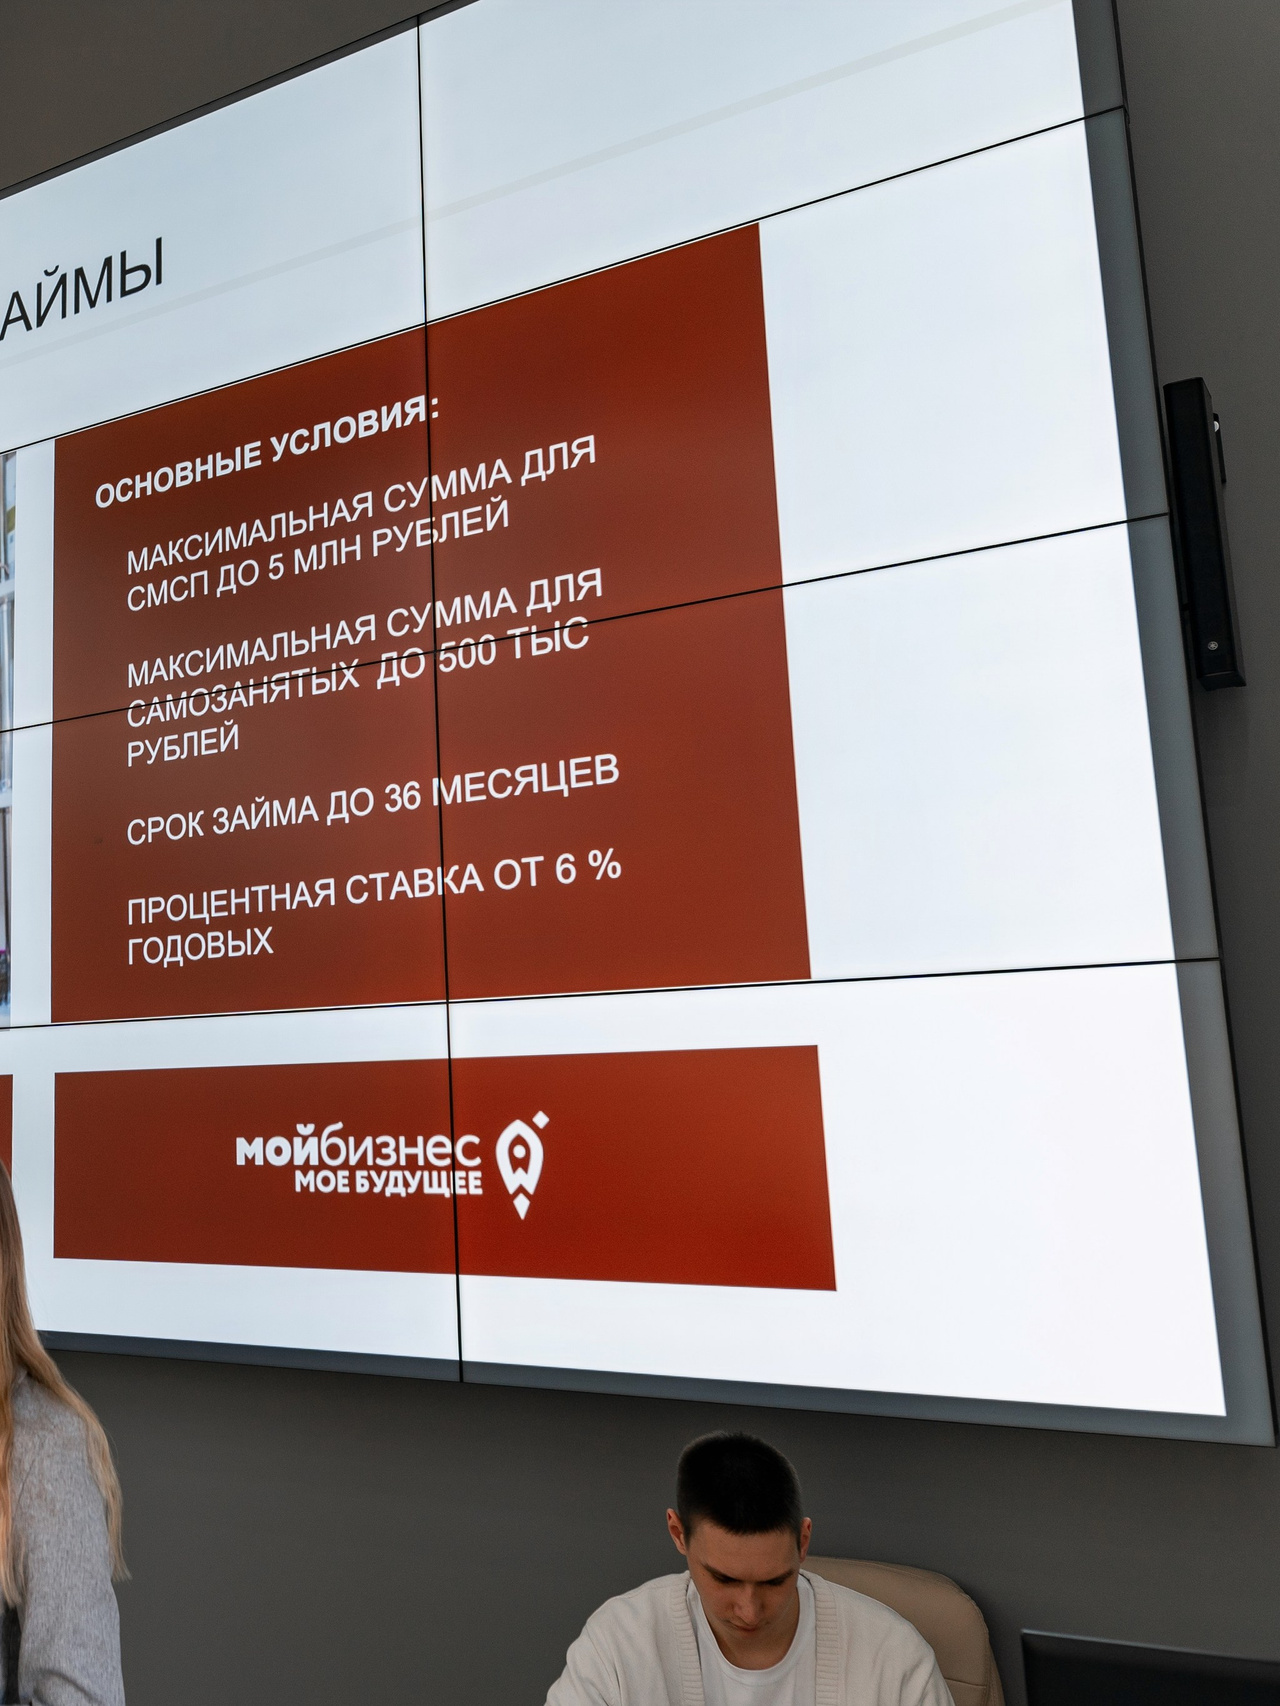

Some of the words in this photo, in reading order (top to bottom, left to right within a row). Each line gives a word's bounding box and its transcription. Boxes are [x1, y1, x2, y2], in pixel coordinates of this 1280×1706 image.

[95, 441, 262, 508] ОСНОВНЫЕ
[270, 395, 439, 462] УСЛОВИЯ:
[127, 491, 373, 575] МАКСИМАЛЬНАЯ
[383, 458, 512, 513] СУММА
[520, 435, 596, 486] ДЛЯ
[127, 572, 209, 612] СМСП
[216, 559, 260, 597] ДО
[269, 554, 284, 580] 5
[293, 534, 361, 574] МЛН
[373, 496, 510, 557] РУБЛЕЙ
[127, 614, 376, 688] МАКСИМАЛЬНАЯ
[387, 587, 517, 640] СУММА
[525, 568, 603, 616] ДЛЯ
[127, 659, 360, 728] САМОЗАНЯТЫХ
[376, 647, 425, 689] ДО
[438, 634, 497, 673] 500
[507, 616, 590, 660] ТЫС
[127, 720, 240, 768] РУБЛЕЙ
[127, 810, 205, 845] СРОК
[213, 795, 319, 835] ЗАЙМА
[327, 788, 374, 825] ДО
[385, 780, 421, 813] 36
[431, 752, 620, 806] МЕСЯЦЕВ
[128, 878, 335, 925] ПРОЦЕНТНАЯ
[345, 863, 484, 904] СТАВКА
[493, 855, 544, 892] ОТ
[555, 853, 577, 885] 6
[588, 847, 622, 881] %
[128, 926, 274, 968] ГОДОВЫХ
[295, 1170, 350, 1193] МОЕ
[355, 1170, 483, 1198] БУДУЩЕЕ
